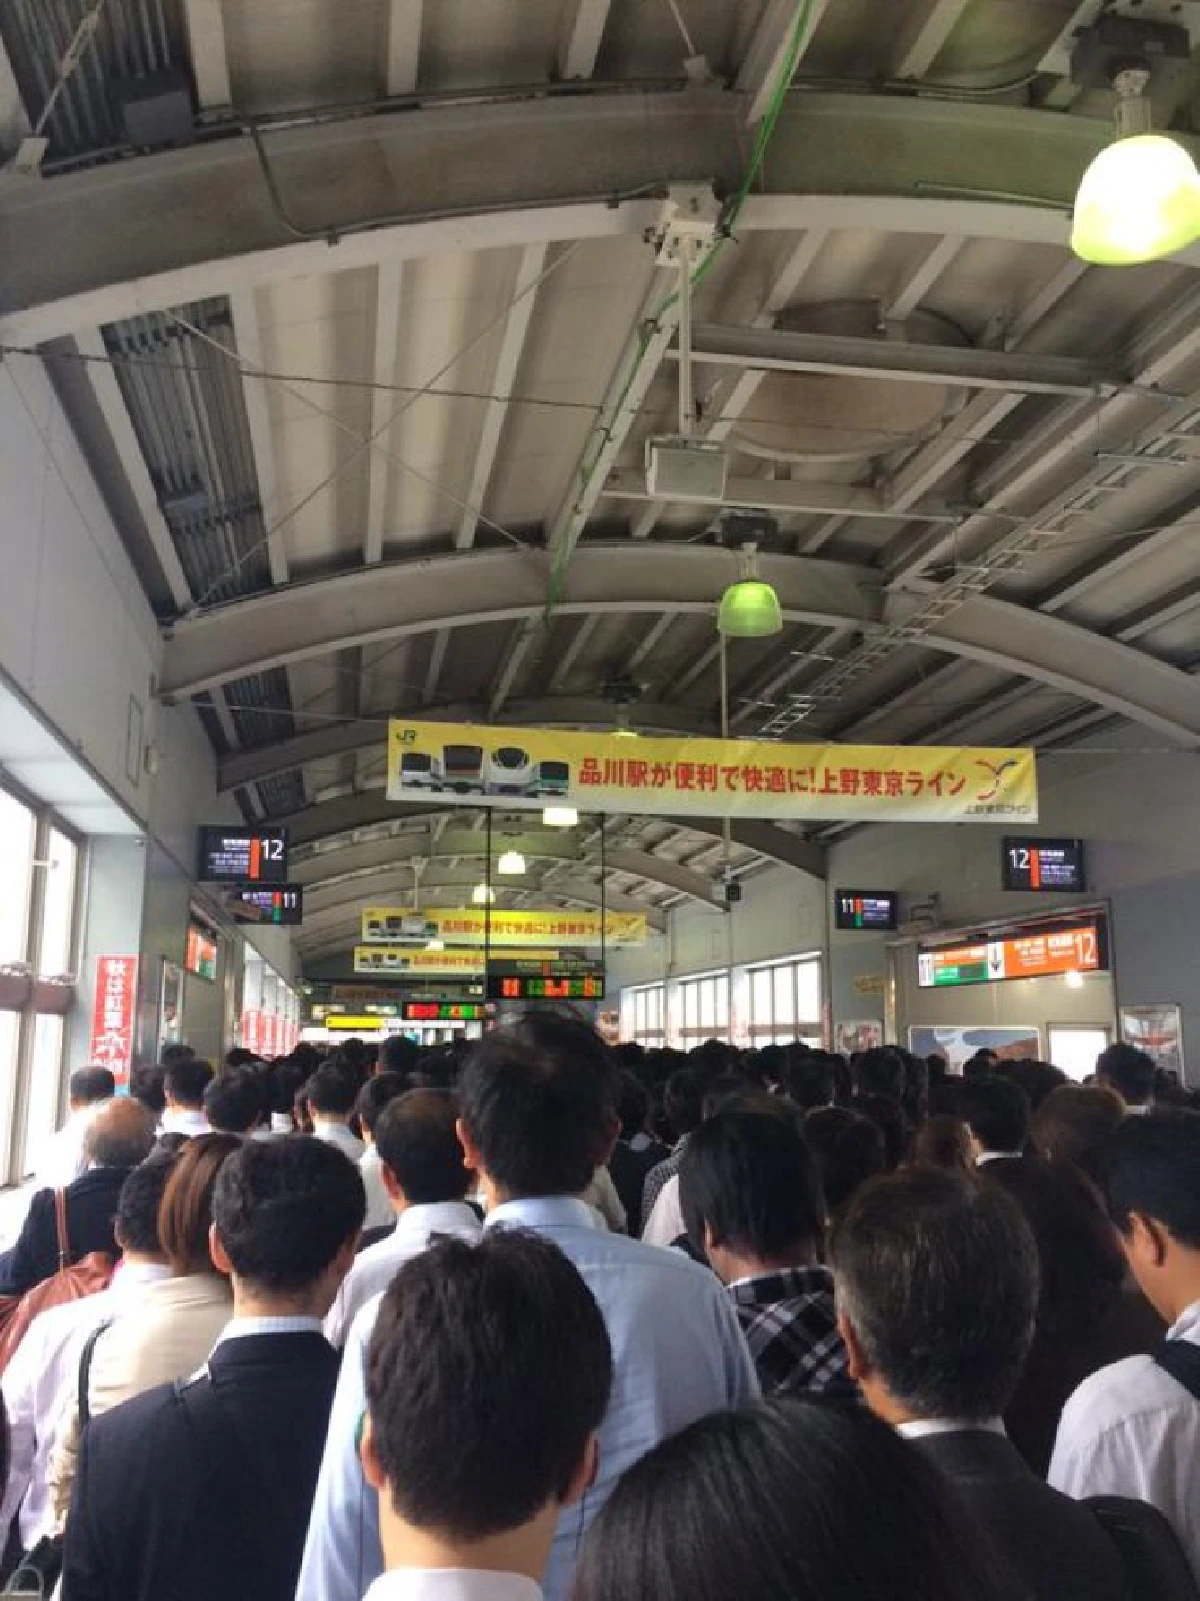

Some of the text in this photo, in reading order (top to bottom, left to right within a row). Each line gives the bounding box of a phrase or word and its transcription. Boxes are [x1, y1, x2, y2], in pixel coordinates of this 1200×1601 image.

[396, 729, 416, 742] JR
[579, 757, 966, 797] 品川駅が便利で快適に!上野東京ライン
[260, 839, 284, 860] 12
[1008, 848, 1030, 869] 12
[284, 892, 297, 908] 11
[841, 898, 854, 912] 11
[1077, 932, 1097, 964] 12
